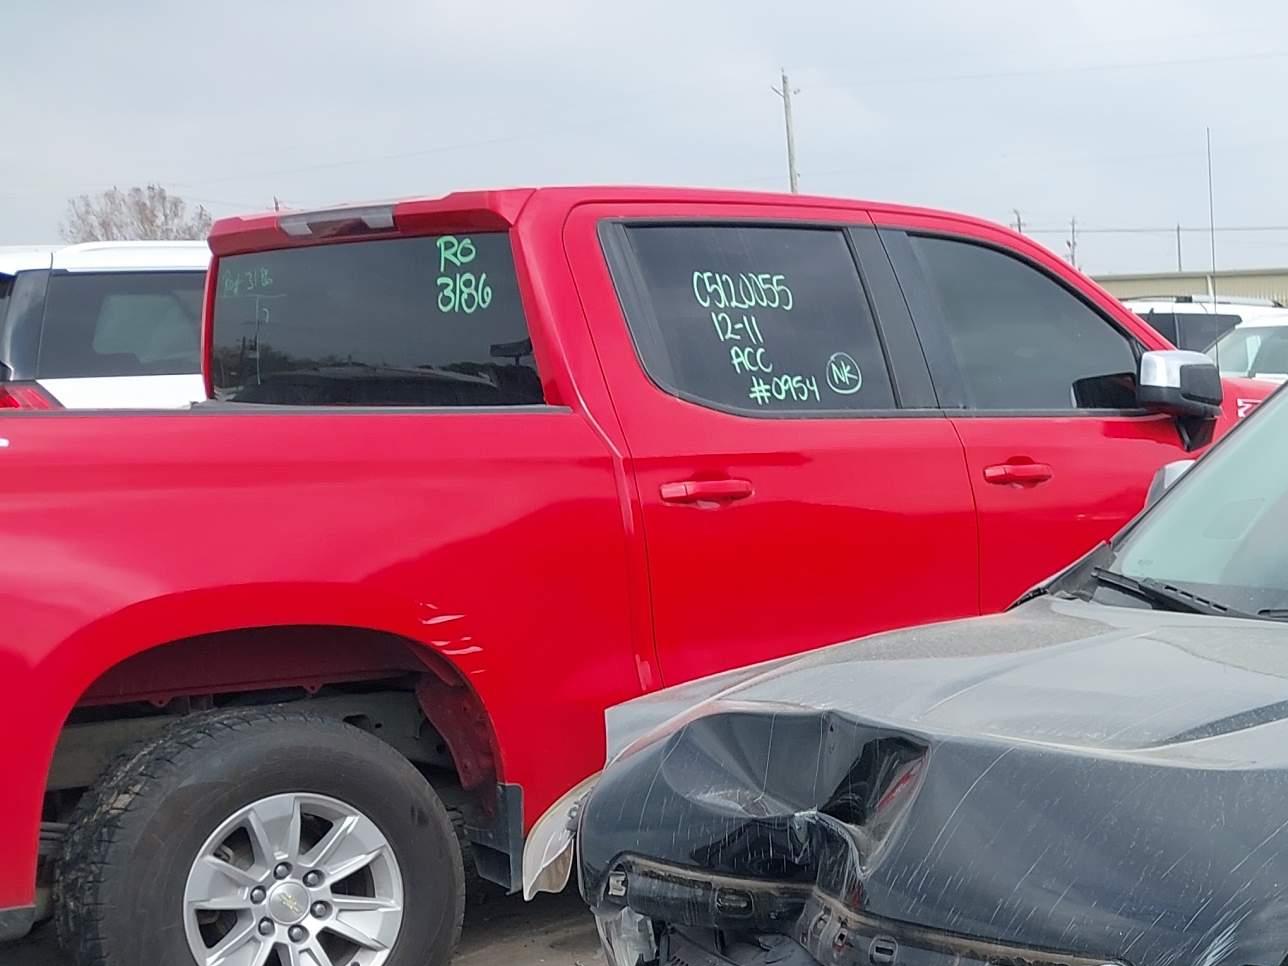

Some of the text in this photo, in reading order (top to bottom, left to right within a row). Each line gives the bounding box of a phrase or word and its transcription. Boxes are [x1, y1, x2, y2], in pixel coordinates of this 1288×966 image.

[436, 272, 493, 314] 3186
[711, 311, 764, 345] 12-11
[730, 346, 773, 374] ACC
[749, 374, 821, 406] #0954
